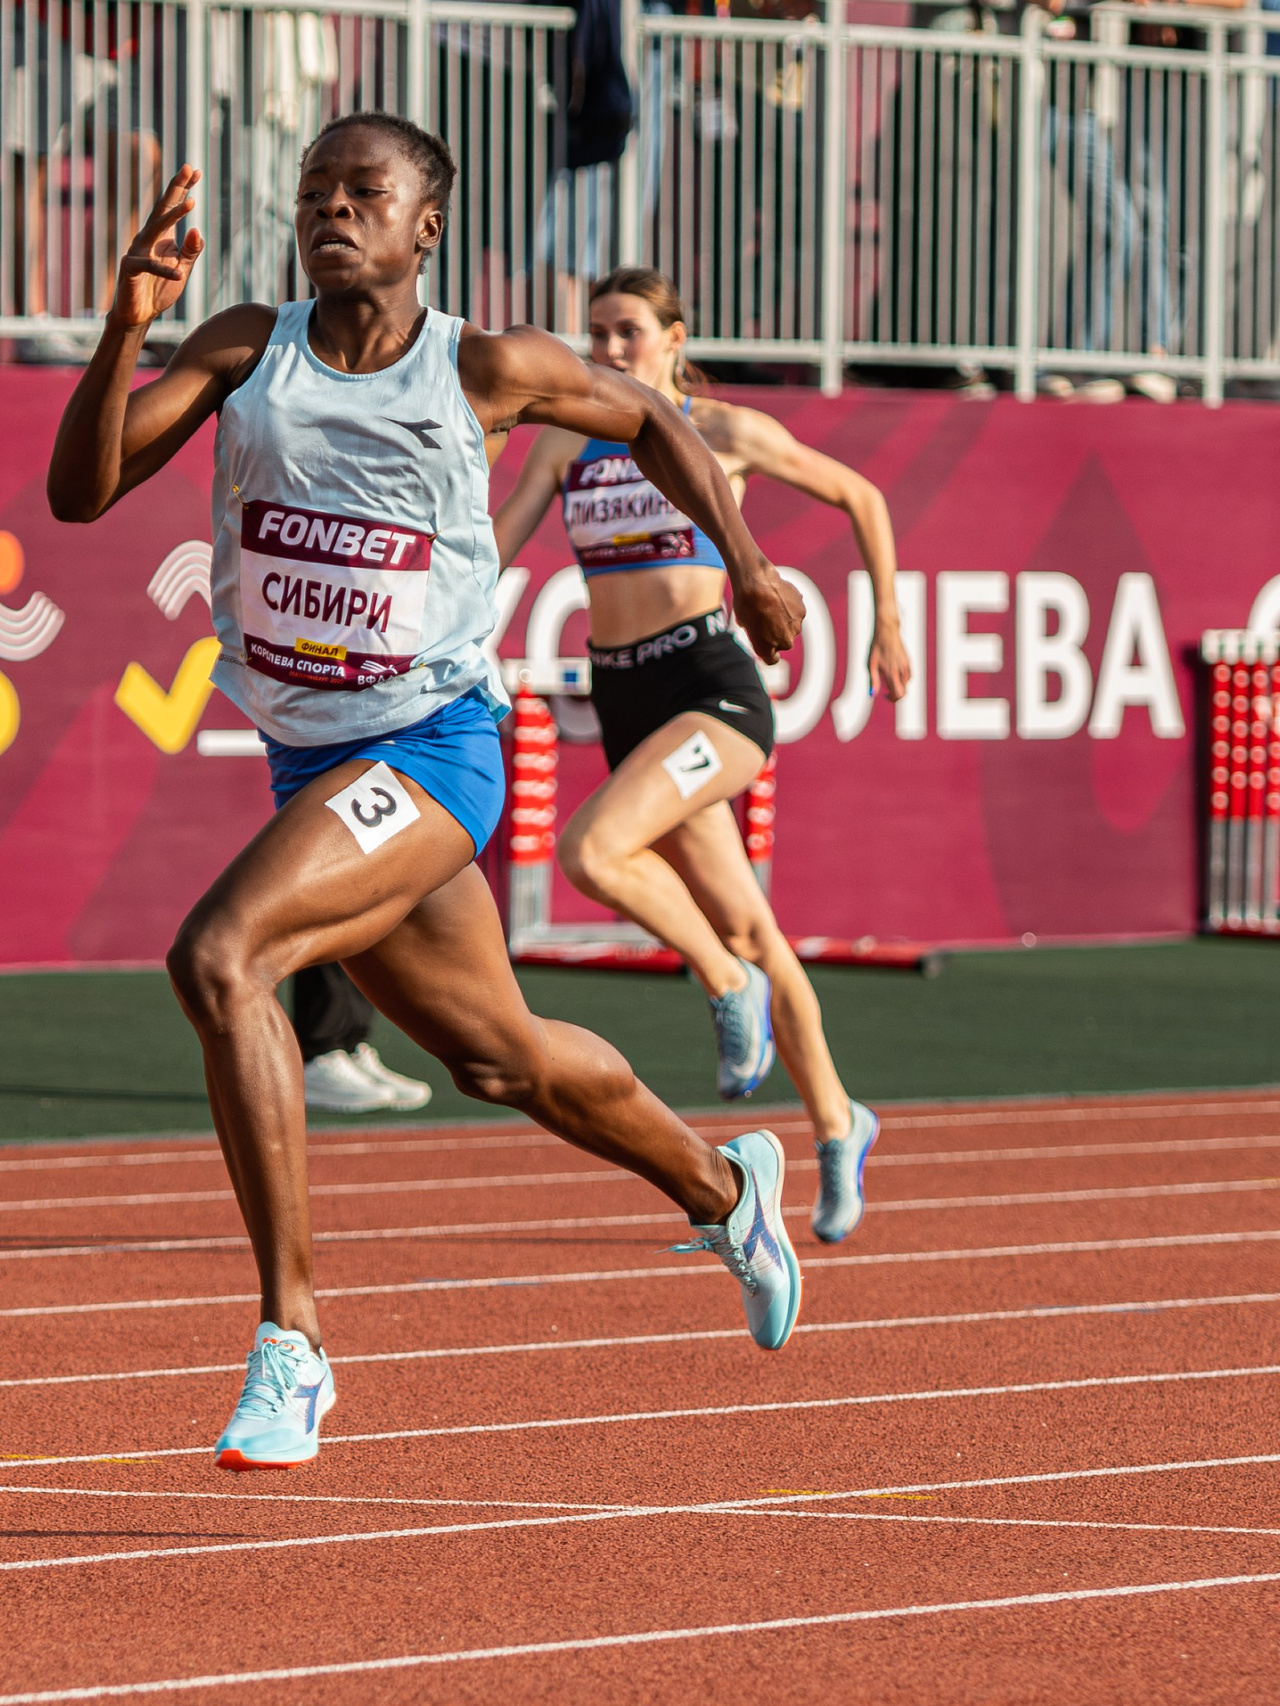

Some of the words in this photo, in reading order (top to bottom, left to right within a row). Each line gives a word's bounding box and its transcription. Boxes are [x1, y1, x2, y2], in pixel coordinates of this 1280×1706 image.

[258, 510, 416, 565] FONBET
[261, 571, 393, 634] СИБИРИ
[301, 641, 339, 657] ФИНАЛ
[636, 624, 699, 666] PRO
[296, 659, 346, 678] СПОРТА
[350, 786, 397, 828] 3
